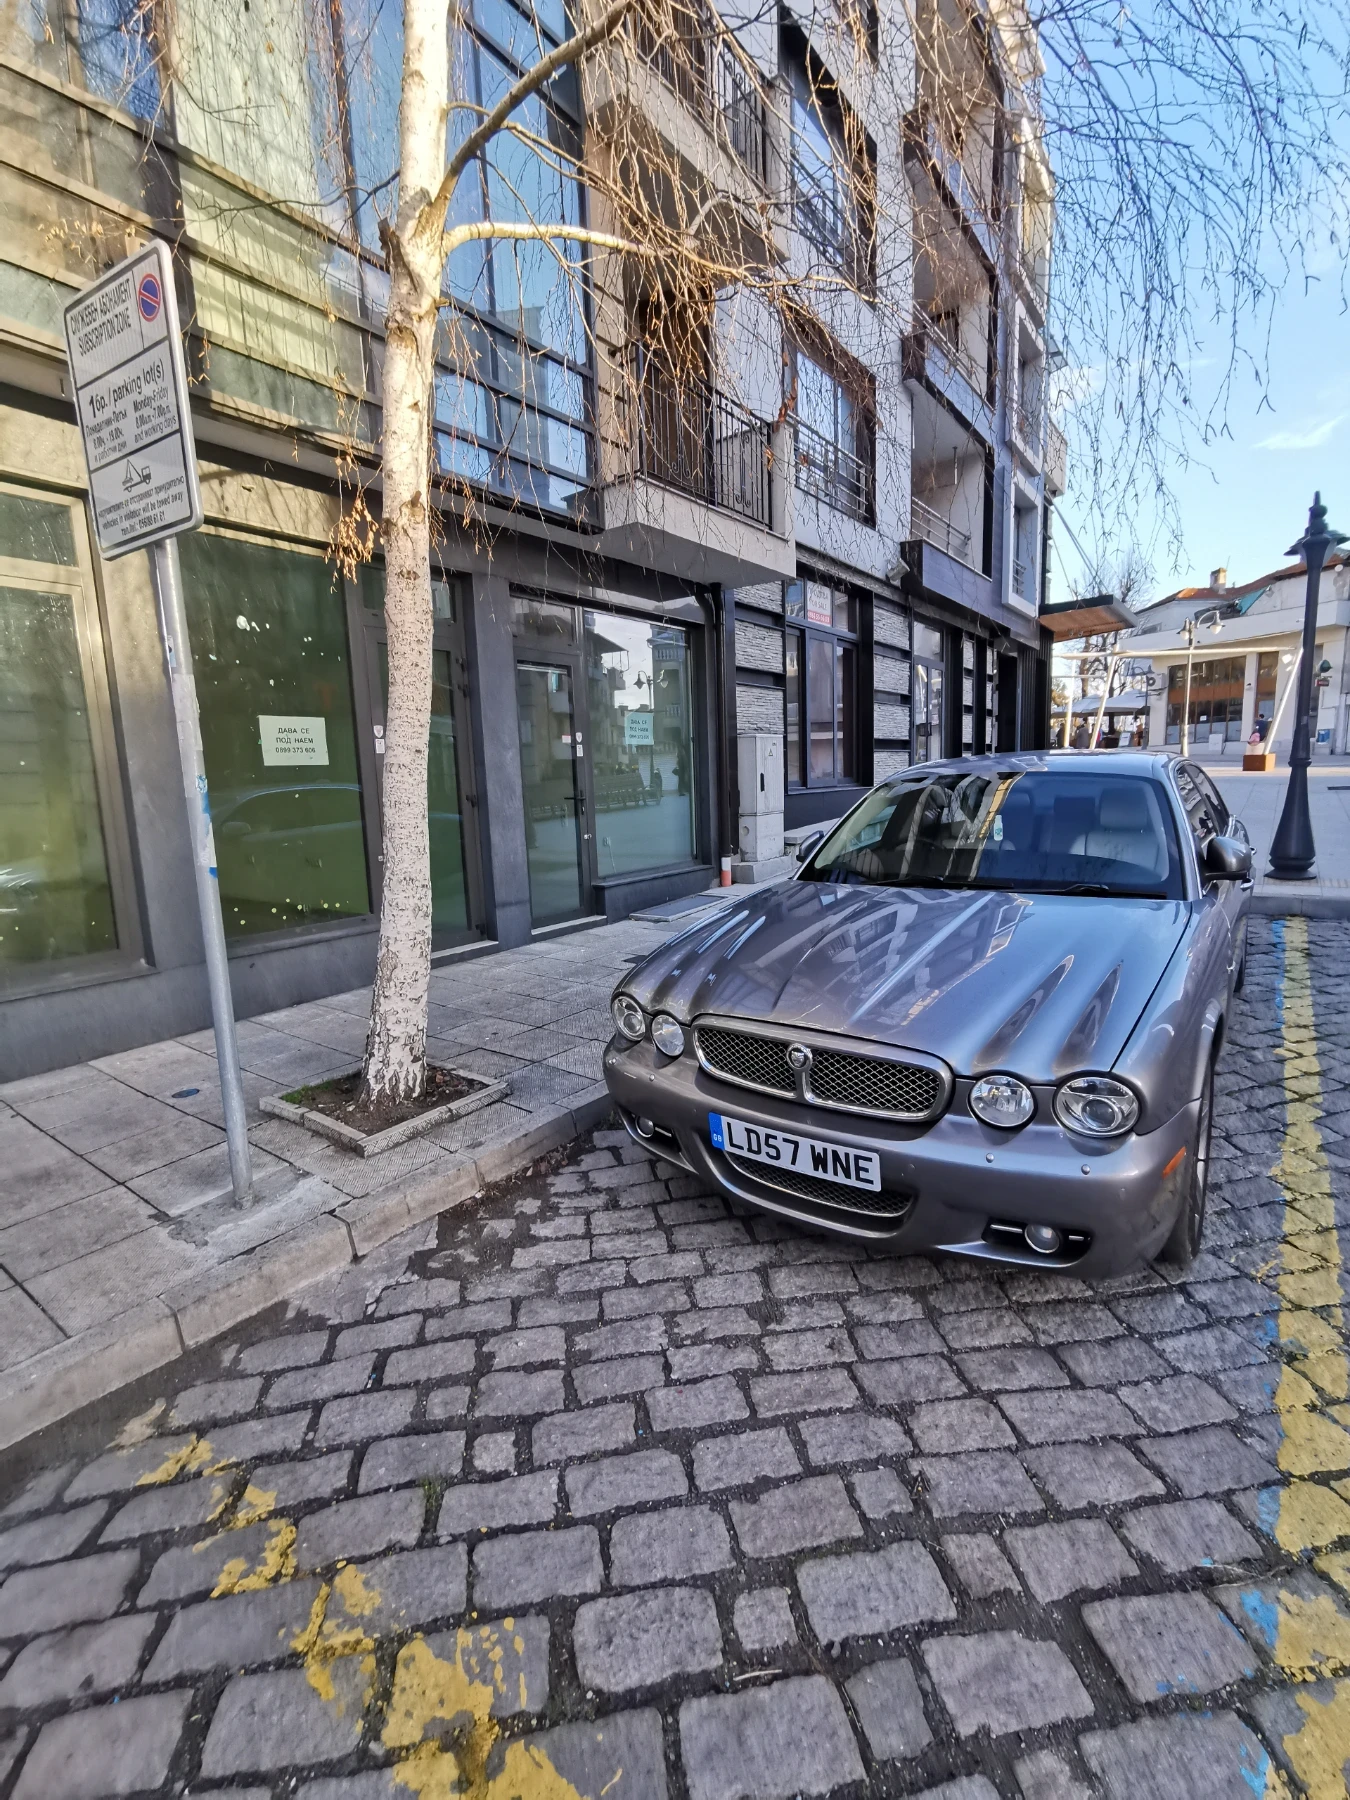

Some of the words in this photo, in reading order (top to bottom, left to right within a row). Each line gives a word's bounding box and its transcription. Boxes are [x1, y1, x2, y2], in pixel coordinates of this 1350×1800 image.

[99, 279, 132, 318] АБОНАМЕНТ
[79, 314, 116, 356] SUBSCRIPTION
[115, 307, 131, 334] ZONE
[112, 375, 142, 408] parking
[143, 358, 165, 385] lot(s)
[134, 430, 144, 444] and
[144, 421, 163, 437] working
[163, 415, 177, 430] days
[141, 503, 150, 514] will
[150, 500, 156, 511] be
[156, 495, 171, 508] towed
[171, 491, 183, 503] away
[713, 1133, 722, 1142] GB
[726, 1121, 800, 1166] LD57
[810, 1144, 874, 1185] WNE
